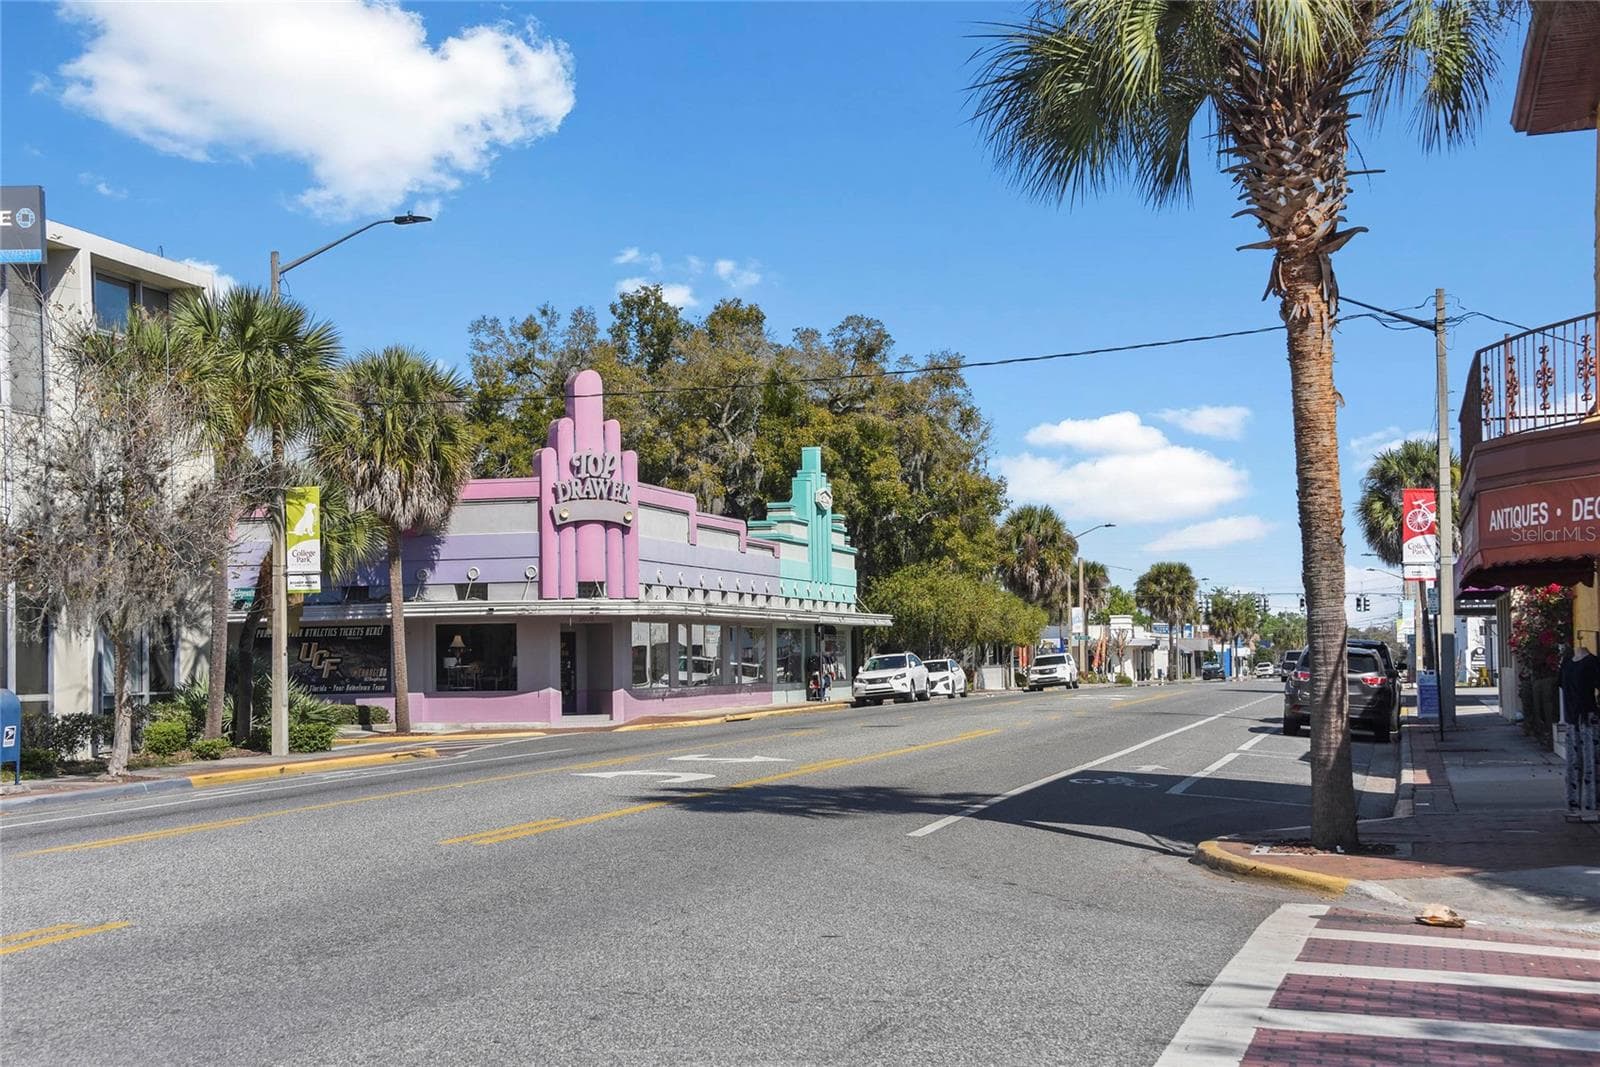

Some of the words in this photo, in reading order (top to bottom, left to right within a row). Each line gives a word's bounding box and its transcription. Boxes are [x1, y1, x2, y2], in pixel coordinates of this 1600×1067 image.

[571, 452, 617, 479] TOP
[554, 478, 631, 503] DRAWER
[1489, 502, 1549, 532] ANTIQUES
[291, 549, 316, 559] College
[305, 627, 338, 637] ATHLETICS
[339, 627, 365, 637] TICKETS
[299, 642, 342, 678] UCF
